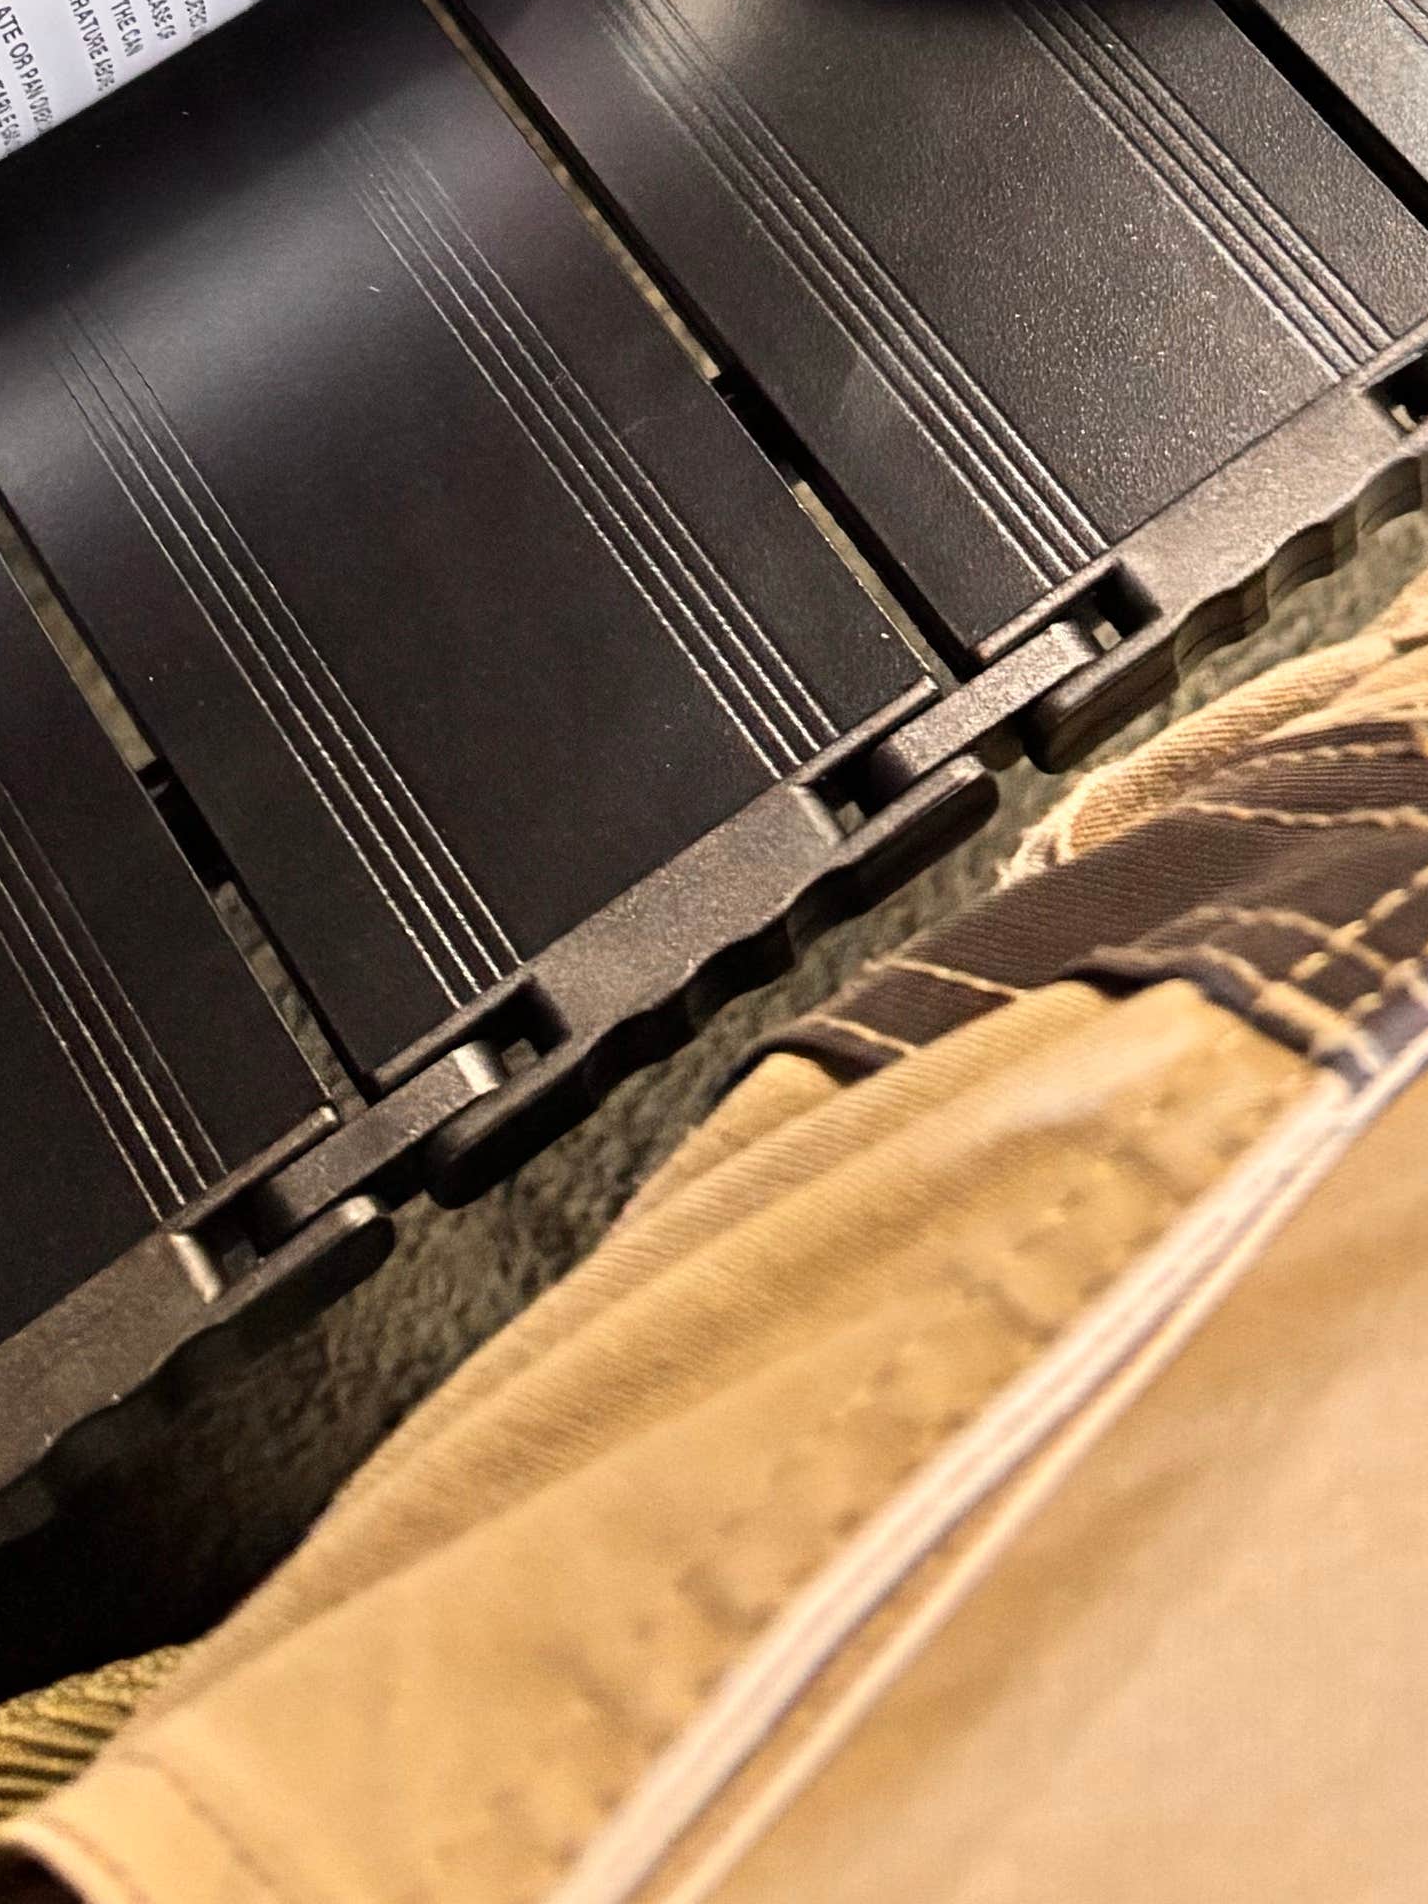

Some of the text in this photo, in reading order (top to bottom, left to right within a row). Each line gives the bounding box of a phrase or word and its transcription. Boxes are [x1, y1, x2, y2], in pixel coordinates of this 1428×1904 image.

[9, 42, 34, 71] OR
[121, 28, 144, 57] CAN
[19, 67, 44, 100] PAN
